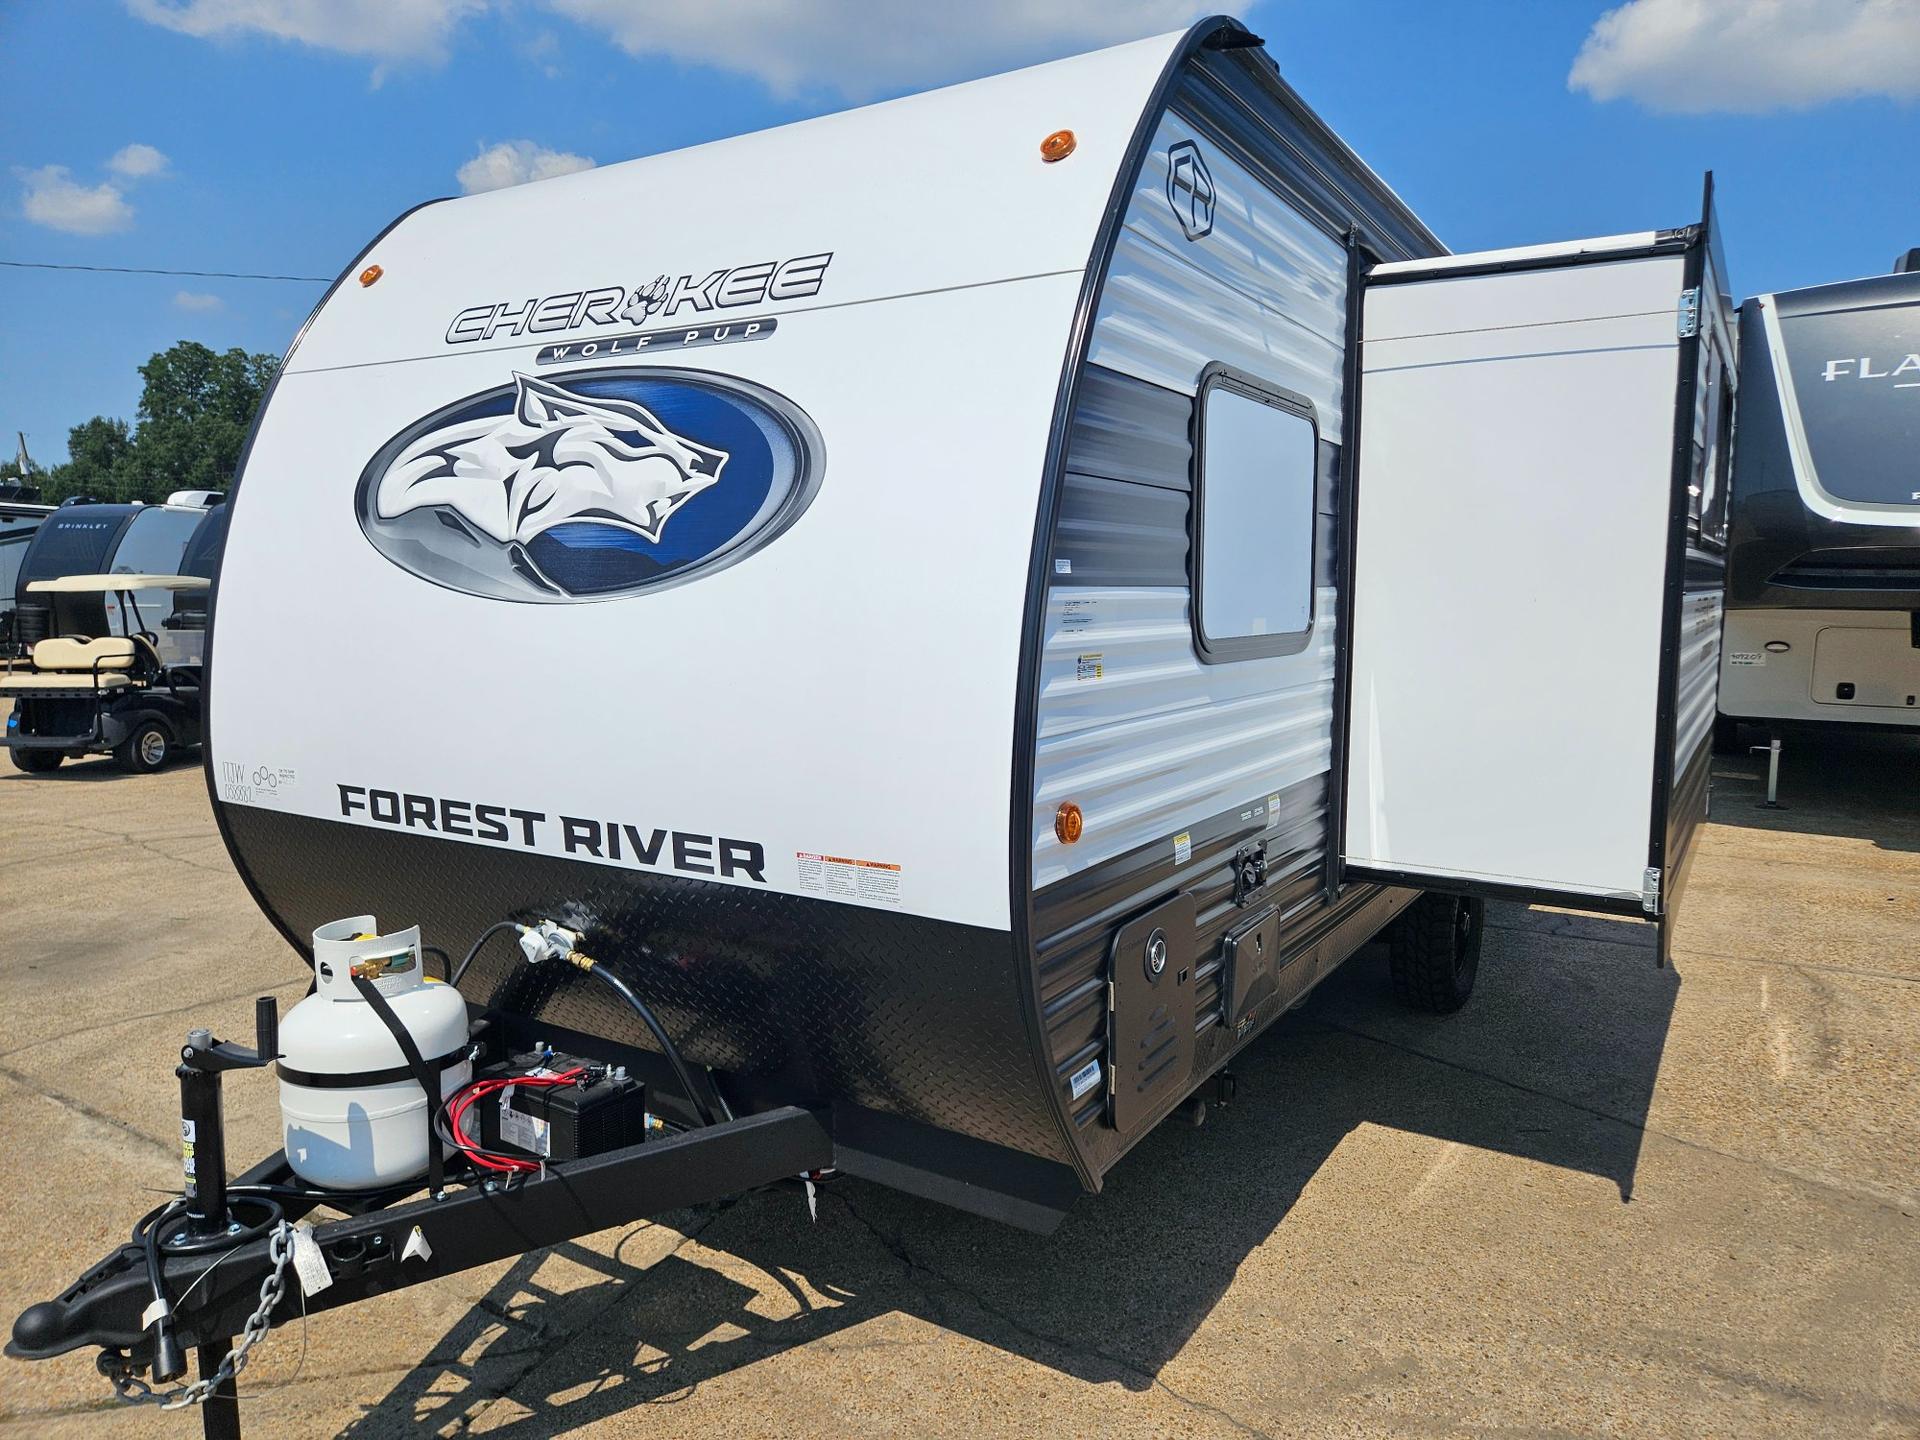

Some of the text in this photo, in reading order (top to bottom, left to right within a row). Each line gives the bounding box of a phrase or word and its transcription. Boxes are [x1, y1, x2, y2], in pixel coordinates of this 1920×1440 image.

[552, 322, 762, 361] WOLF PUP
[57, 522, 109, 530] BRINKLEY
[336, 783, 546, 847] FOREST
[558, 815, 768, 883] RIVER
